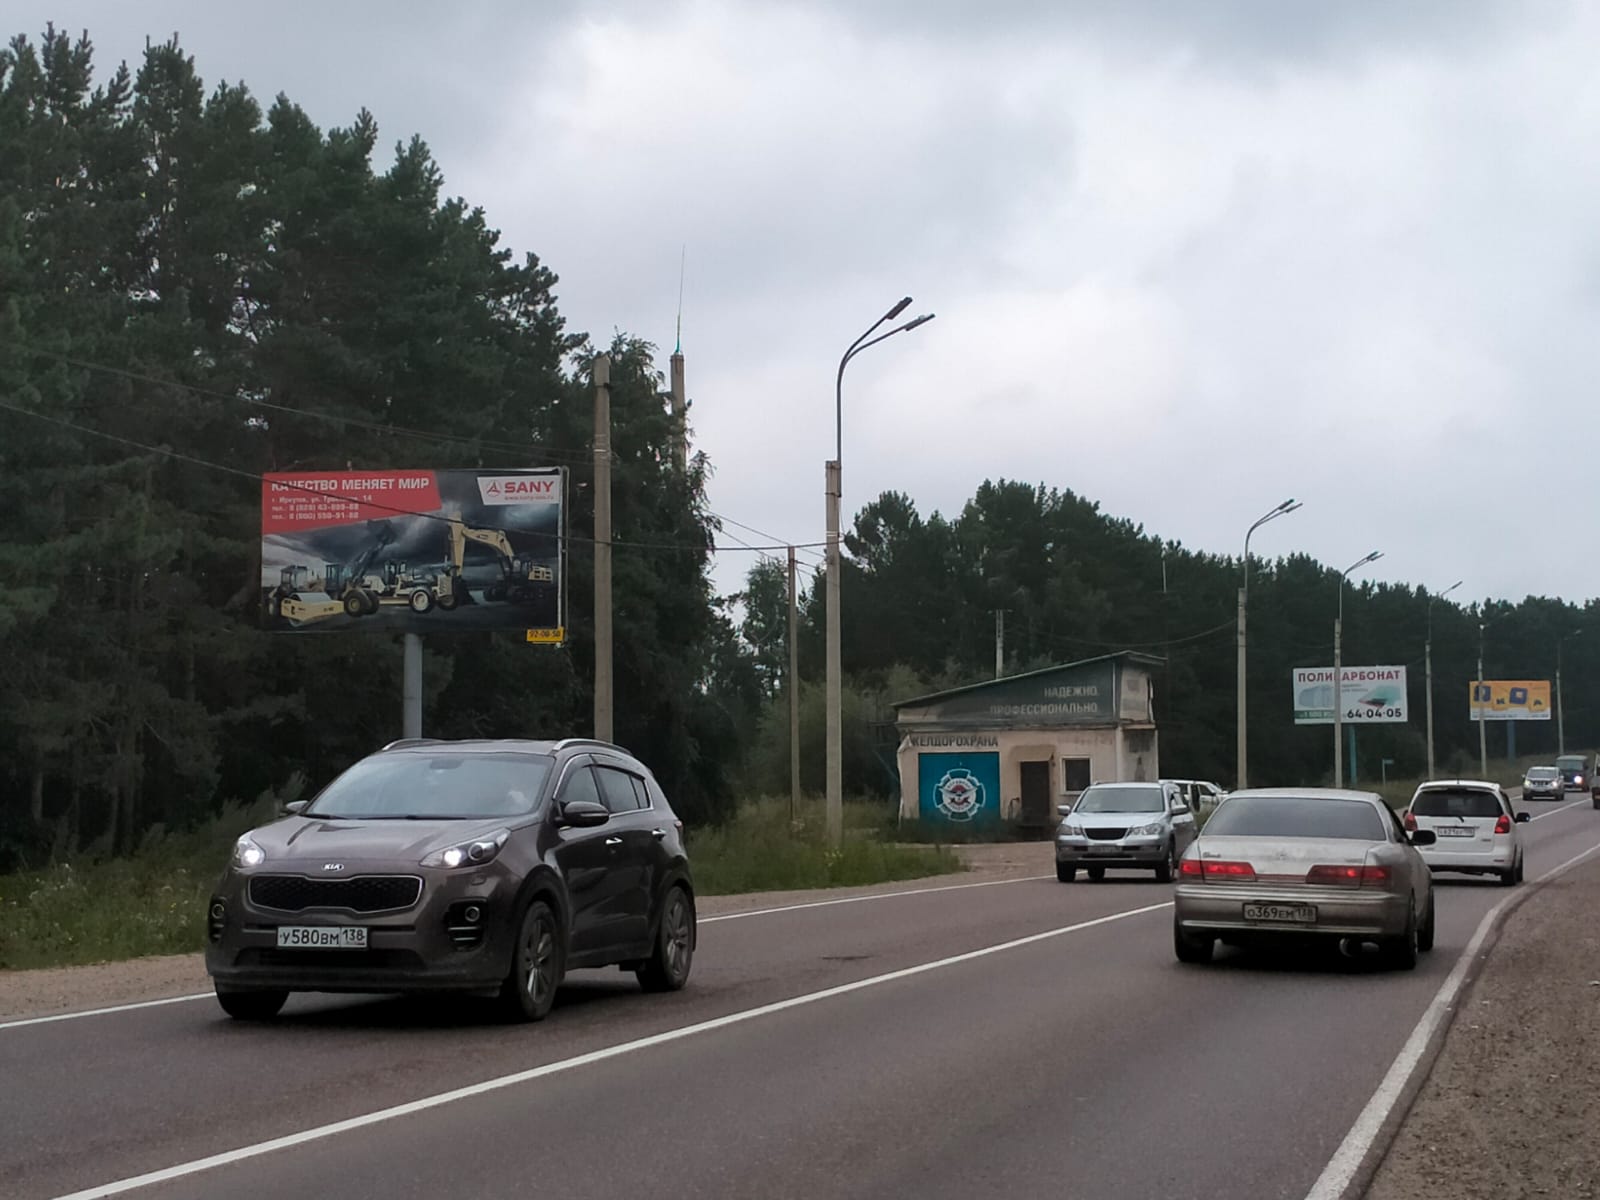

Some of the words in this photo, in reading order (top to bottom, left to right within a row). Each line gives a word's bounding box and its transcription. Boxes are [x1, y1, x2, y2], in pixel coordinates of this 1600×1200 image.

[271, 479, 338, 491] КАЧЕСТВО
[342, 478, 395, 490] МЕНЯЕТ
[398, 477, 430, 489] МИР
[504, 481, 554, 493] SANY
[1297, 670, 1401, 683] ПОЛИАРБОНАТ
[342, 928, 365, 942] 138
